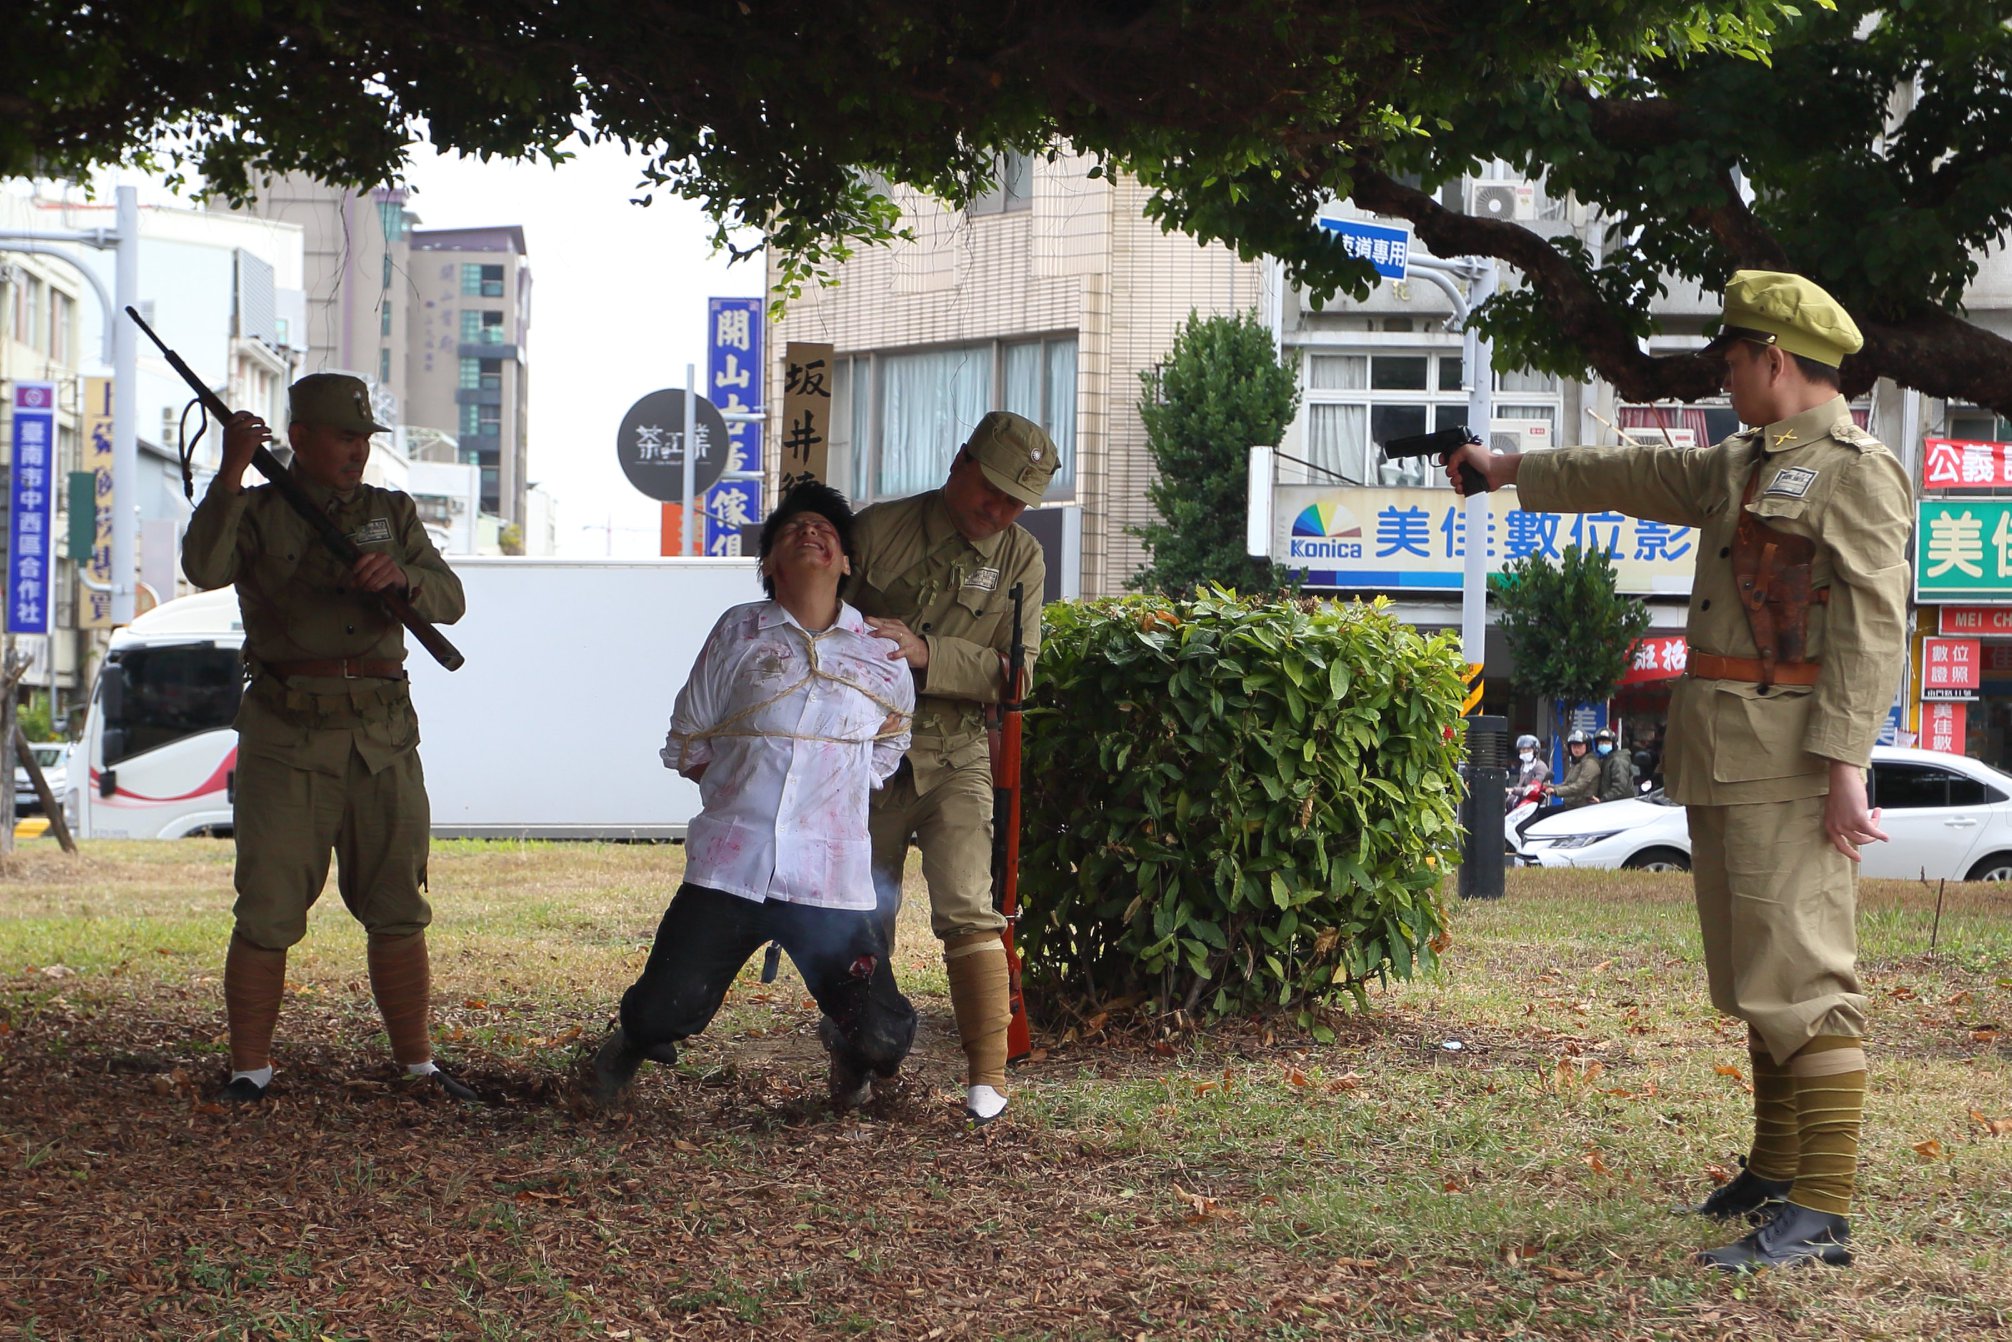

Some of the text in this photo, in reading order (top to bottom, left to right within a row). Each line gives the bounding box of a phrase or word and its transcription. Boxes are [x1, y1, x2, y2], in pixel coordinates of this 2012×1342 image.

[1291, 539, 1362, 558] Konica
[1955, 612, 1982, 627] MEI
[1932, 645, 1969, 663] 數位
[1931, 666, 1969, 683] 證照
